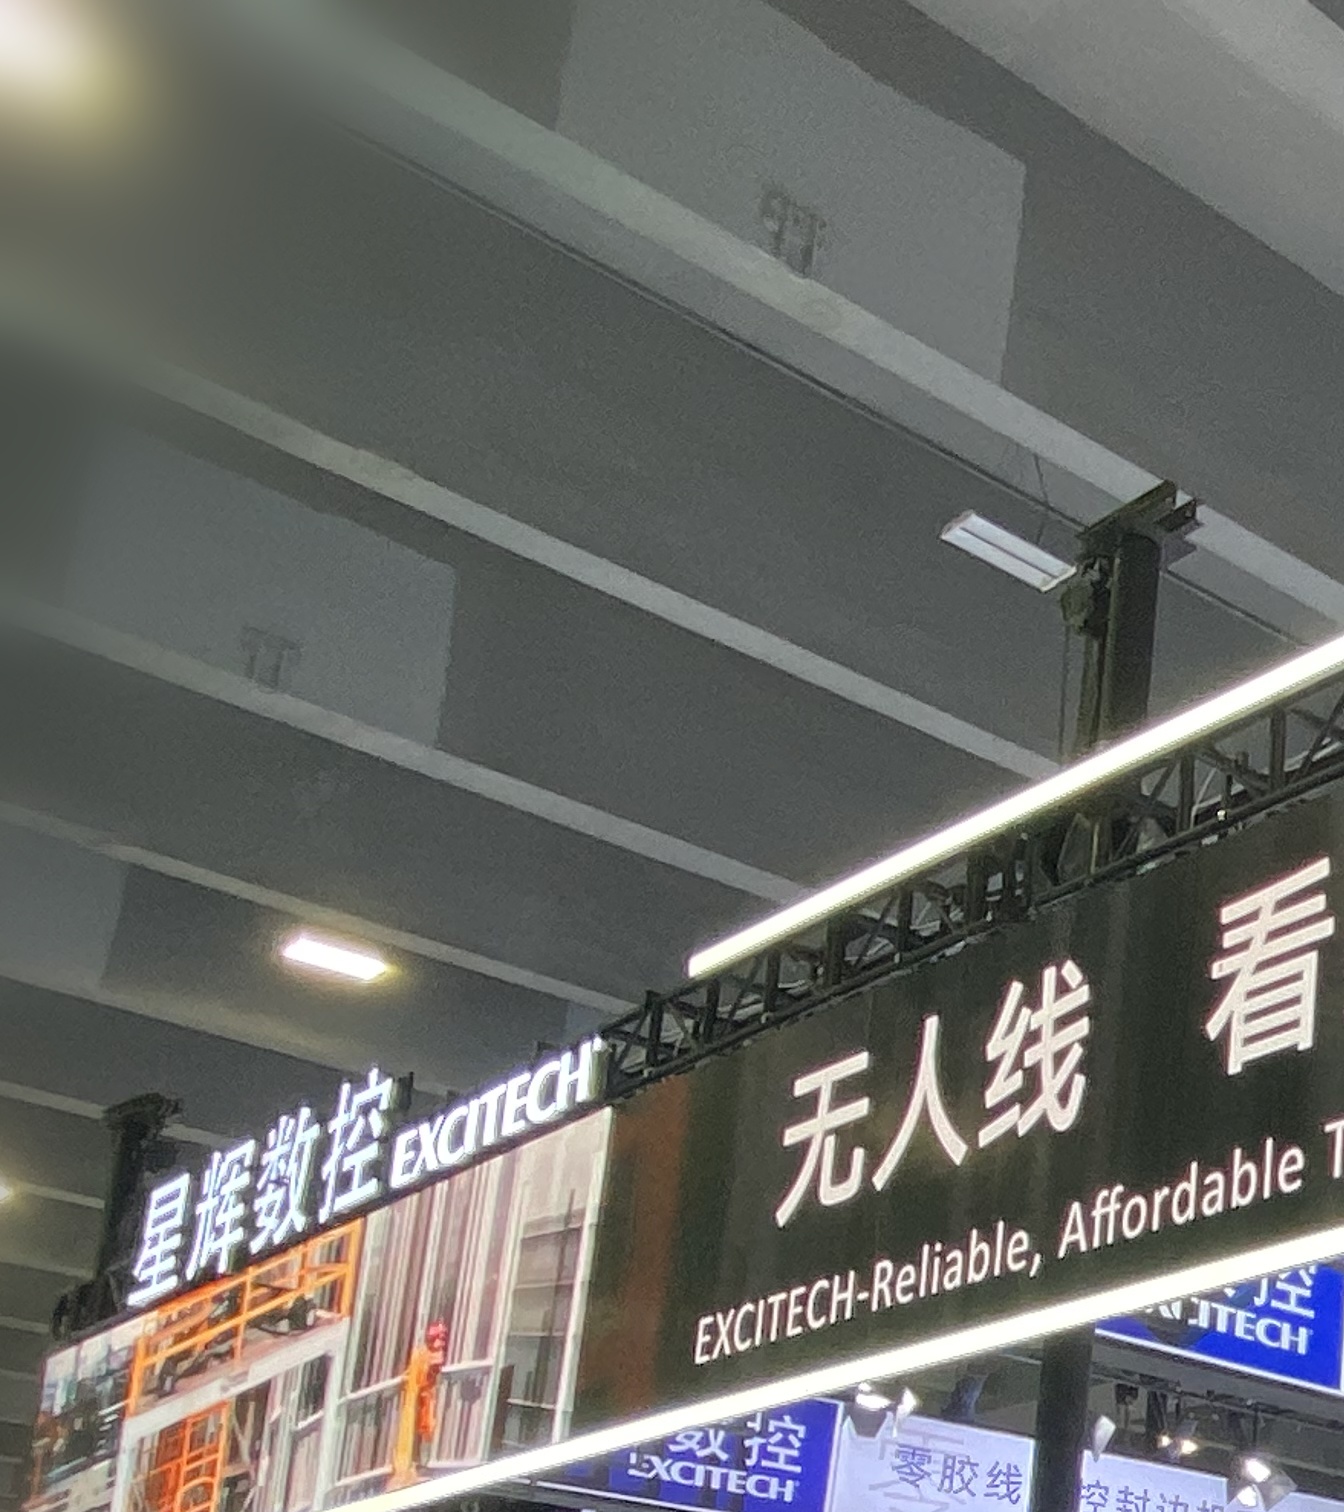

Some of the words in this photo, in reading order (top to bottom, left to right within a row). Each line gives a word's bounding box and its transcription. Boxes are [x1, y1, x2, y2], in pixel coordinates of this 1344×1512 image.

[126, 1066, 396, 1307] 星辉数控
[390, 1038, 600, 1188] EXCITECH
[774, 958, 1094, 1229] 无人线
[692, 1219, 1043, 1365] EXCITECH-Reliable,
[1057, 1137, 1305, 1260] Affordable
[890, 1445, 1025, 1506] 零胶线
